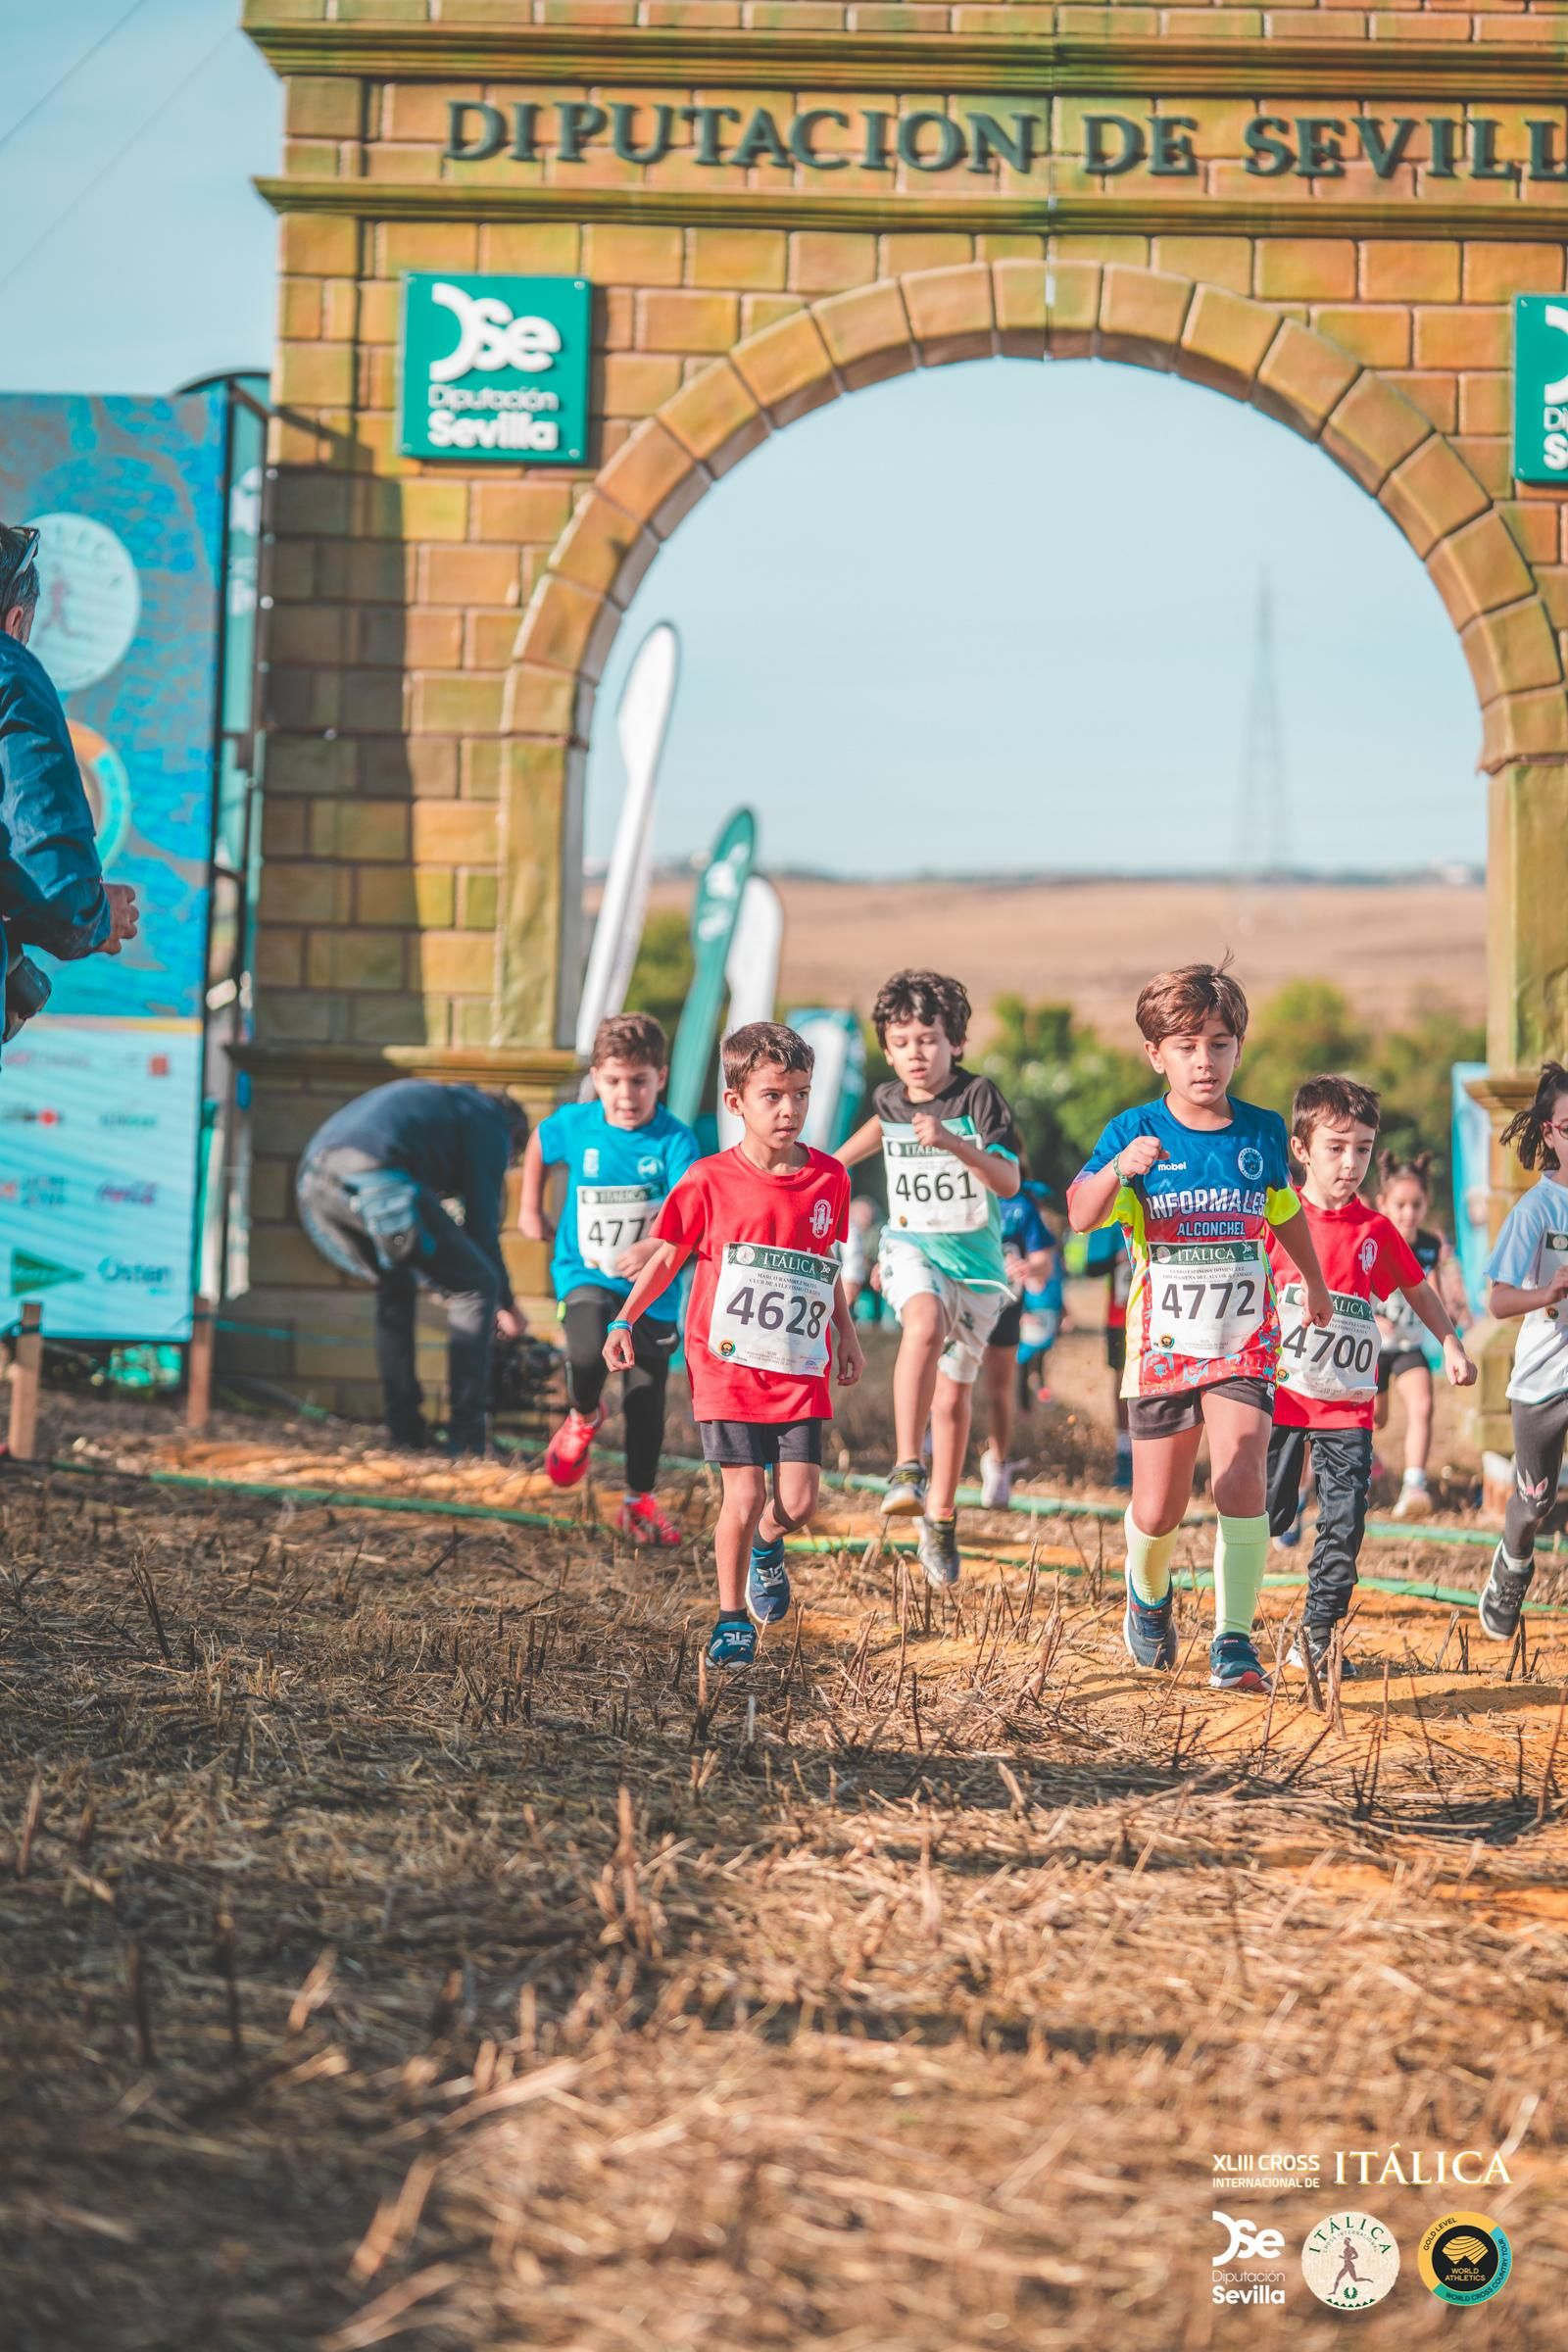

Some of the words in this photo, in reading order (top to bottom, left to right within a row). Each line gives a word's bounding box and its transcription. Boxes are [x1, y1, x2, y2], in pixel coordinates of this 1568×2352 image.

[446, 101, 1040, 174] DIPUTACION
[1081, 115, 1200, 177] DE
[1243, 116, 1568, 180] SEVILL
[427, 383, 560, 413] Diputación
[427, 411, 559, 451] Sevilla
[1158, 1161, 1187, 1172] mobel
[896, 1171, 977, 1201] 4661
[1146, 1188, 1266, 1221] INFORMALES
[588, 1213, 659, 1247] 477
[1177, 1221, 1246, 1237] ALCONCHEL
[762, 1251, 815, 1275] ITÁLICA
[1178, 1247, 1237, 1262] ITÁLICA
[726, 1287, 827, 1340] 4628
[1161, 1279, 1255, 1320] 4772
[1332, 1296, 1364, 1315] ÁLICA
[1282, 1325, 1374, 1373] 4700
